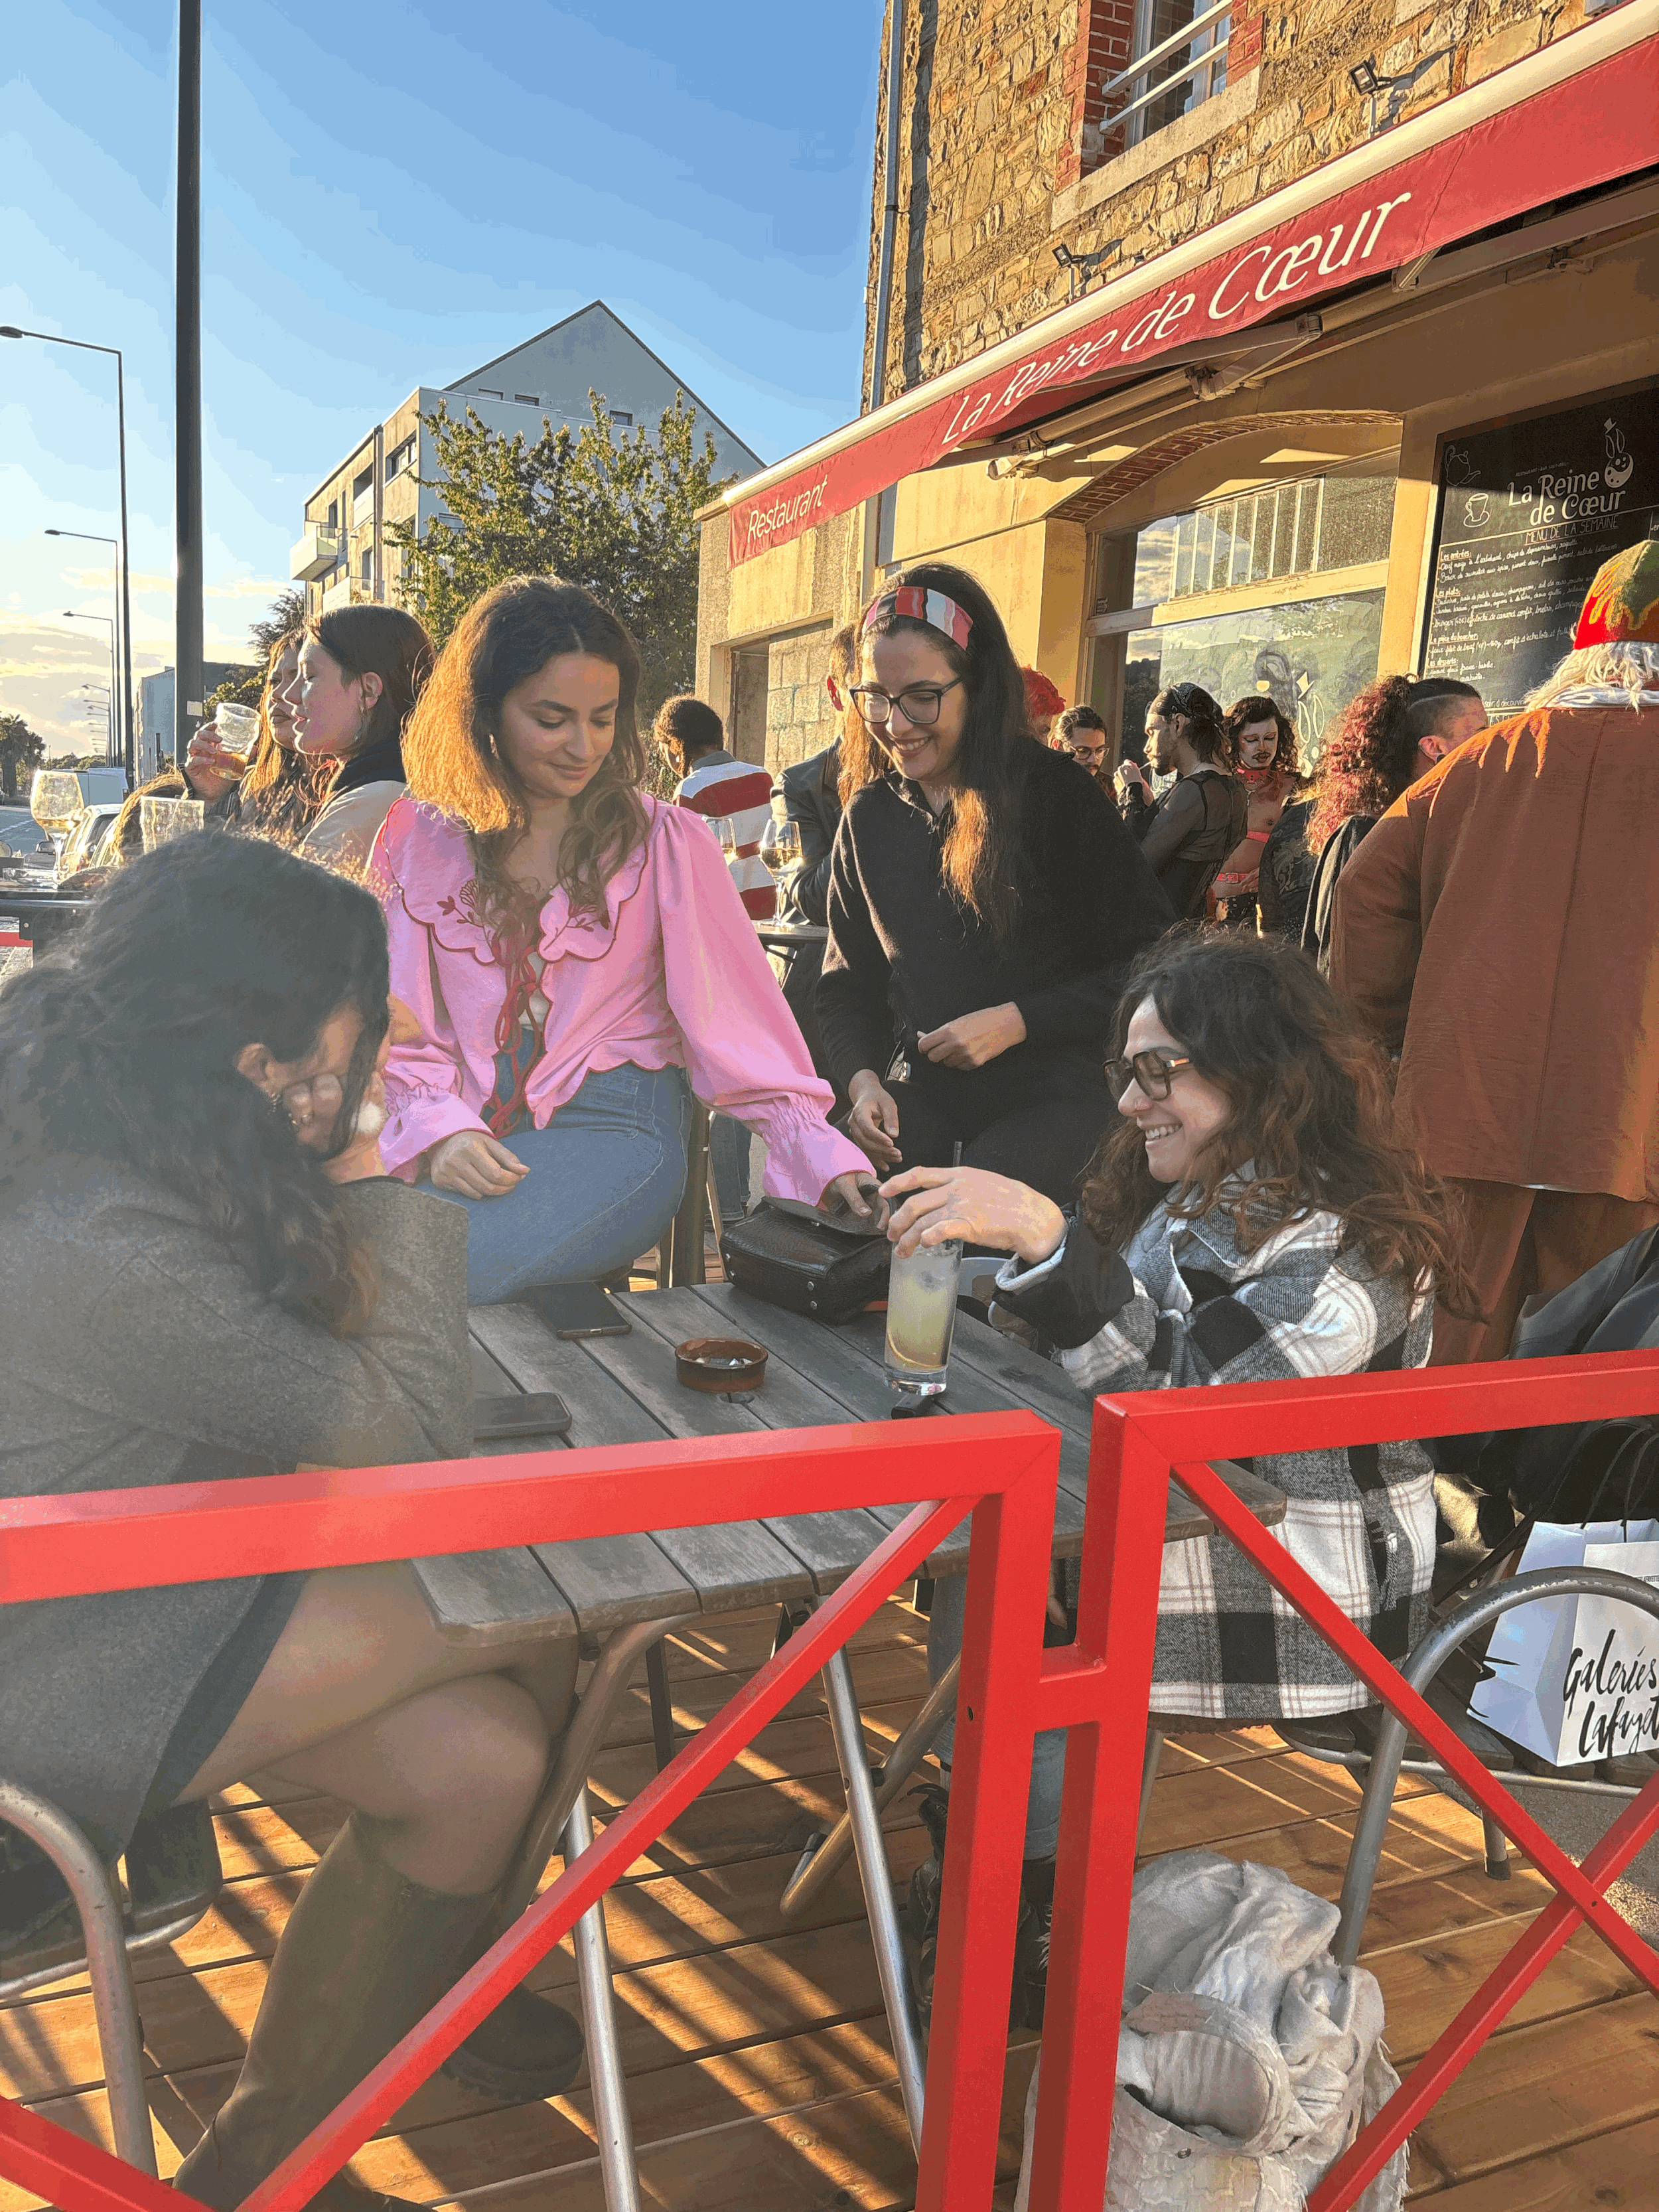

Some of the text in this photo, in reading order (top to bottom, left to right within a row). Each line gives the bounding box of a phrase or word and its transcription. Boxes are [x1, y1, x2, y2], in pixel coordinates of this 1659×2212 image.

[942, 192, 1411, 445] La Reine de Cœur
[1507, 469, 1600, 506] La Reine
[747, 474, 828, 543] Restaurant
[1530, 490, 1626, 526] de Cœur
[1526, 515, 1619, 544] MENU DE LA SEMAINE
[1440, 548, 1449, 561] Les
[1435, 587, 1444, 597] Les
